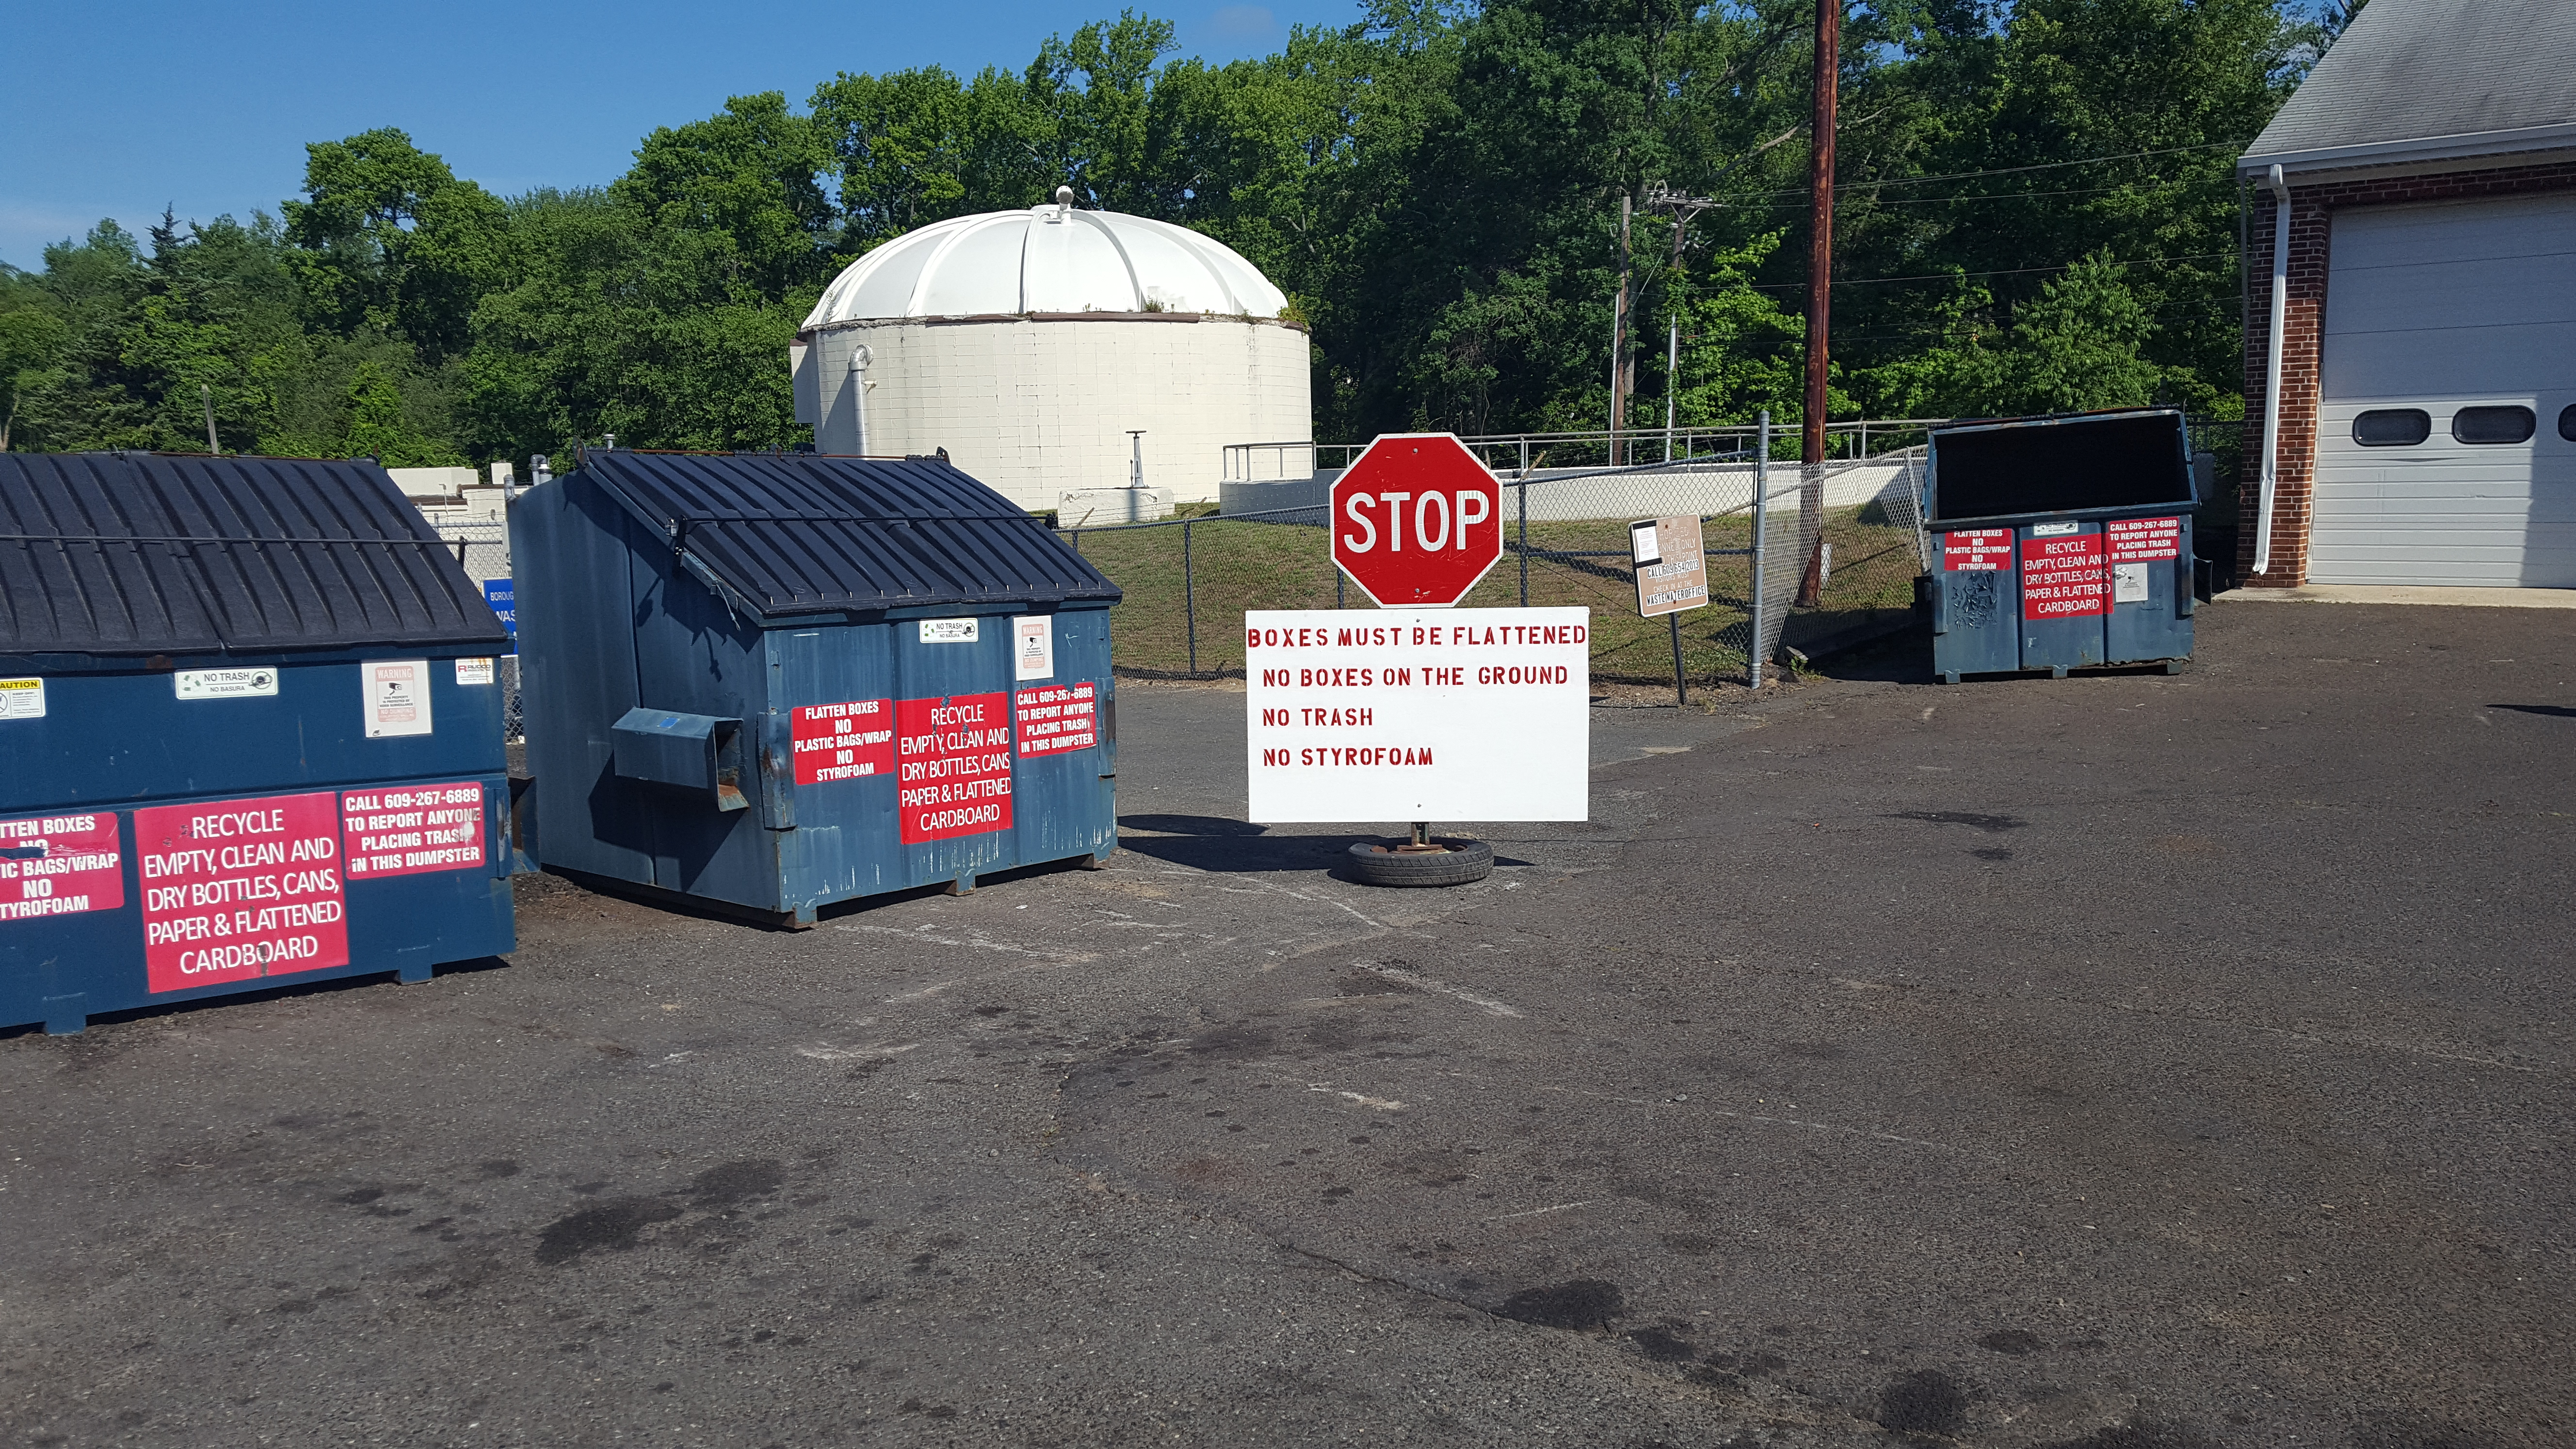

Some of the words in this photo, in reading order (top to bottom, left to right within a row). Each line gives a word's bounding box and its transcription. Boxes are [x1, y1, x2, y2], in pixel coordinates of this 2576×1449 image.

[1344, 490, 1489, 553] STOP
[2129, 520, 2177, 530] 609-267-6889
[1681, 538, 1696, 549] ONLY
[2121, 531, 2148, 540] REPORT
[2150, 530, 2177, 538] ANYONE
[2045, 541, 2086, 554] RECYCLE
[2117, 541, 2146, 549] PLACING
[2139, 549, 2176, 558] DUMPSTER
[1682, 550, 1697, 562] POINT
[2025, 558, 2056, 570] EMPTY,
[2058, 556, 2085, 567] CLEAN
[2089, 554, 2109, 565] AND
[1648, 568, 1662, 578] CALL
[1663, 565, 1673, 575] 609
[1674, 563, 1685, 573] 654
[1687, 560, 1698, 570] 2013
[1655, 574, 1675, 583] VISITORS
[2026, 574, 2043, 585] DRY
[2045, 571, 2083, 583] BOTTLES,
[2085, 568, 2110, 580] CANS,
[1647, 593, 1665, 605] WASTE
[1666, 590, 1685, 602] WATER
[1685, 585, 1705, 598] OFFICE
[2026, 588, 2052, 600] PAPER
[2054, 587, 2061, 597] &
[2063, 583, 2110, 597] FLATTENED
[2038, 599, 2099, 613] CARDBOARD
[1248, 628, 1328, 647] BOXES
[1338, 628, 1402, 646] MUST
[1413, 628, 1442, 645] BE
[1454, 626, 1586, 645] FLATTENED
[220, 672, 249, 681] TRASH
[377, 669, 412, 678] WARNING
[1263, 669, 1290, 687] NO
[1301, 669, 1373, 686] BOXES
[1384, 668, 1410, 686] ON
[1422, 668, 1464, 686] THE
[1479, 666, 1568, 684] GROUND
[1018, 693, 1038, 705] CALL
[1039, 687, 1092, 703] 609-267-6889
[805, 705, 846, 720] FLATTEN
[849, 701, 879, 715] BOXES
[931, 704, 984, 725] RECYCLE
[1017, 709, 1028, 721] TO
[1030, 706, 1061, 720] REPORT
[1063, 702, 1094, 715] ANYONE
[1263, 708, 1289, 726] NO
[1302, 708, 1373, 726] TRASH
[835, 719, 852, 734] NO
[1027, 722, 1060, 736] PLACING
[1062, 718, 1087, 731] TRASH
[795, 737, 834, 753] PLASTIC
[837, 730, 891, 747] BAGS/WRAP
[947, 730, 983, 750] CLEAN
[986, 727, 1009, 746] AND
[1021, 741, 1030, 753] IN
[1031, 739, 1049, 751] THIS
[1052, 733, 1093, 748] DUMPSTER
[837, 750, 853, 764] NO
[1263, 748, 1290, 766] NO
[1302, 748, 1433, 766] STYROFOAM
[817, 763, 874, 781] STYROFOAM
[902, 761, 927, 781] DRY
[930, 756, 980, 778] BOTTLES,
[346, 796, 381, 811] CALL
[385, 789, 479, 808] 609-267-6889
[902, 787, 939, 807] PAPER
[942, 784, 951, 803] &
[954, 777, 1011, 801] FLATTENED
[43, 816, 96, 835] BOXES
[192, 809, 285, 839] RECYCLE
[345, 817, 365, 832] TO
[369, 812, 423, 830] REPORT
[427, 808, 480, 825] ANYONE
[921, 804, 999, 831] CARDBOARD
[361, 832, 421, 851] PLACING
[0, 863, 18, 878] IC
[23, 853, 118, 876] BAGS/WRAP
[145, 849, 218, 878] EMPTY,
[221, 842, 285, 869] CLEAN
[291, 837, 335, 862] AND
[352, 857, 367, 872] IN
[370, 854, 402, 870] THIS
[406, 847, 479, 867] DUMPSTER
[23, 879, 52, 898] NO
[147, 885, 188, 911] DRY
[192, 875, 281, 906] BOTTLES,
[284, 869, 339, 894] CANS,
[149, 917, 211, 945] PAPER
[214, 913, 232, 936] &
[236, 901, 341, 934] FLATTENED
[180, 936, 318, 974] CARDBOARD
